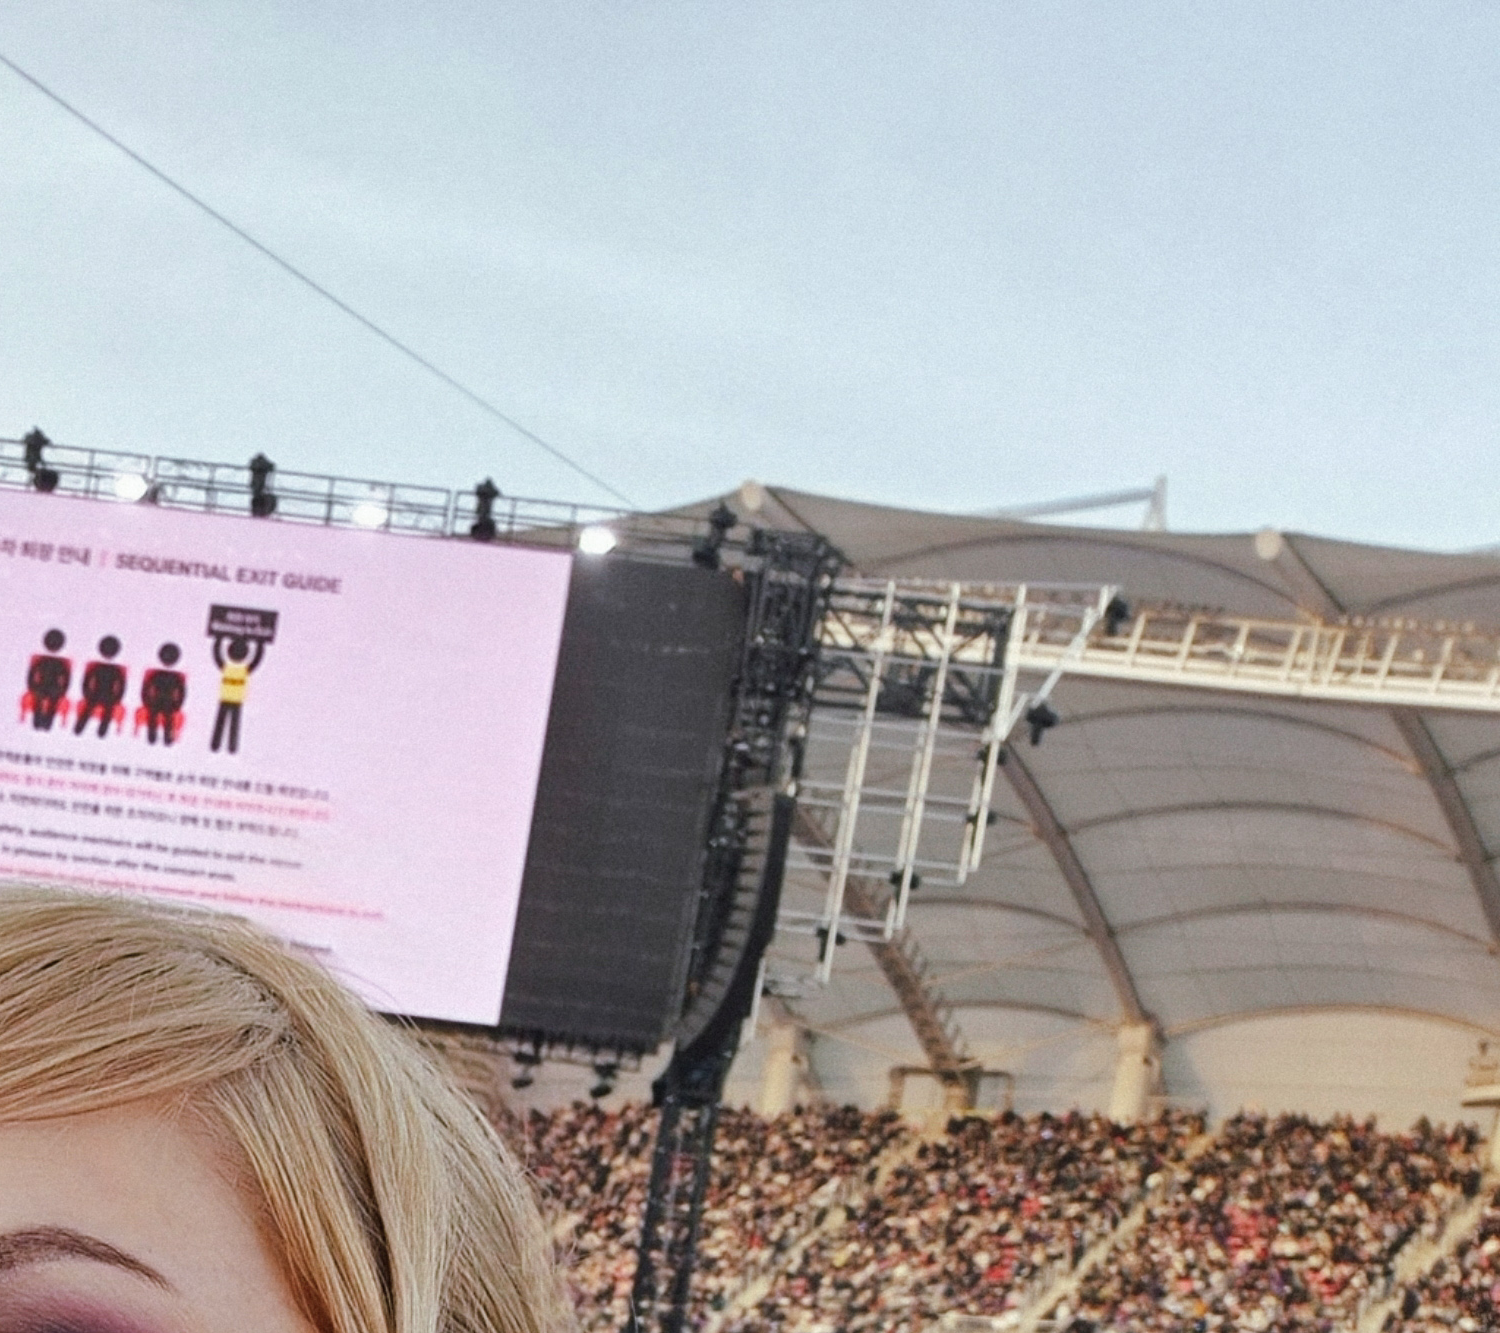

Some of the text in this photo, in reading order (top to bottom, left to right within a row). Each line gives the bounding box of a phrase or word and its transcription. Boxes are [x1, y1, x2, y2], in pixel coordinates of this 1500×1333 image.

[114, 553, 232, 582] SEQUENTIAL
[234, 567, 276, 587] EXIT
[281, 572, 343, 595] GUIDE
